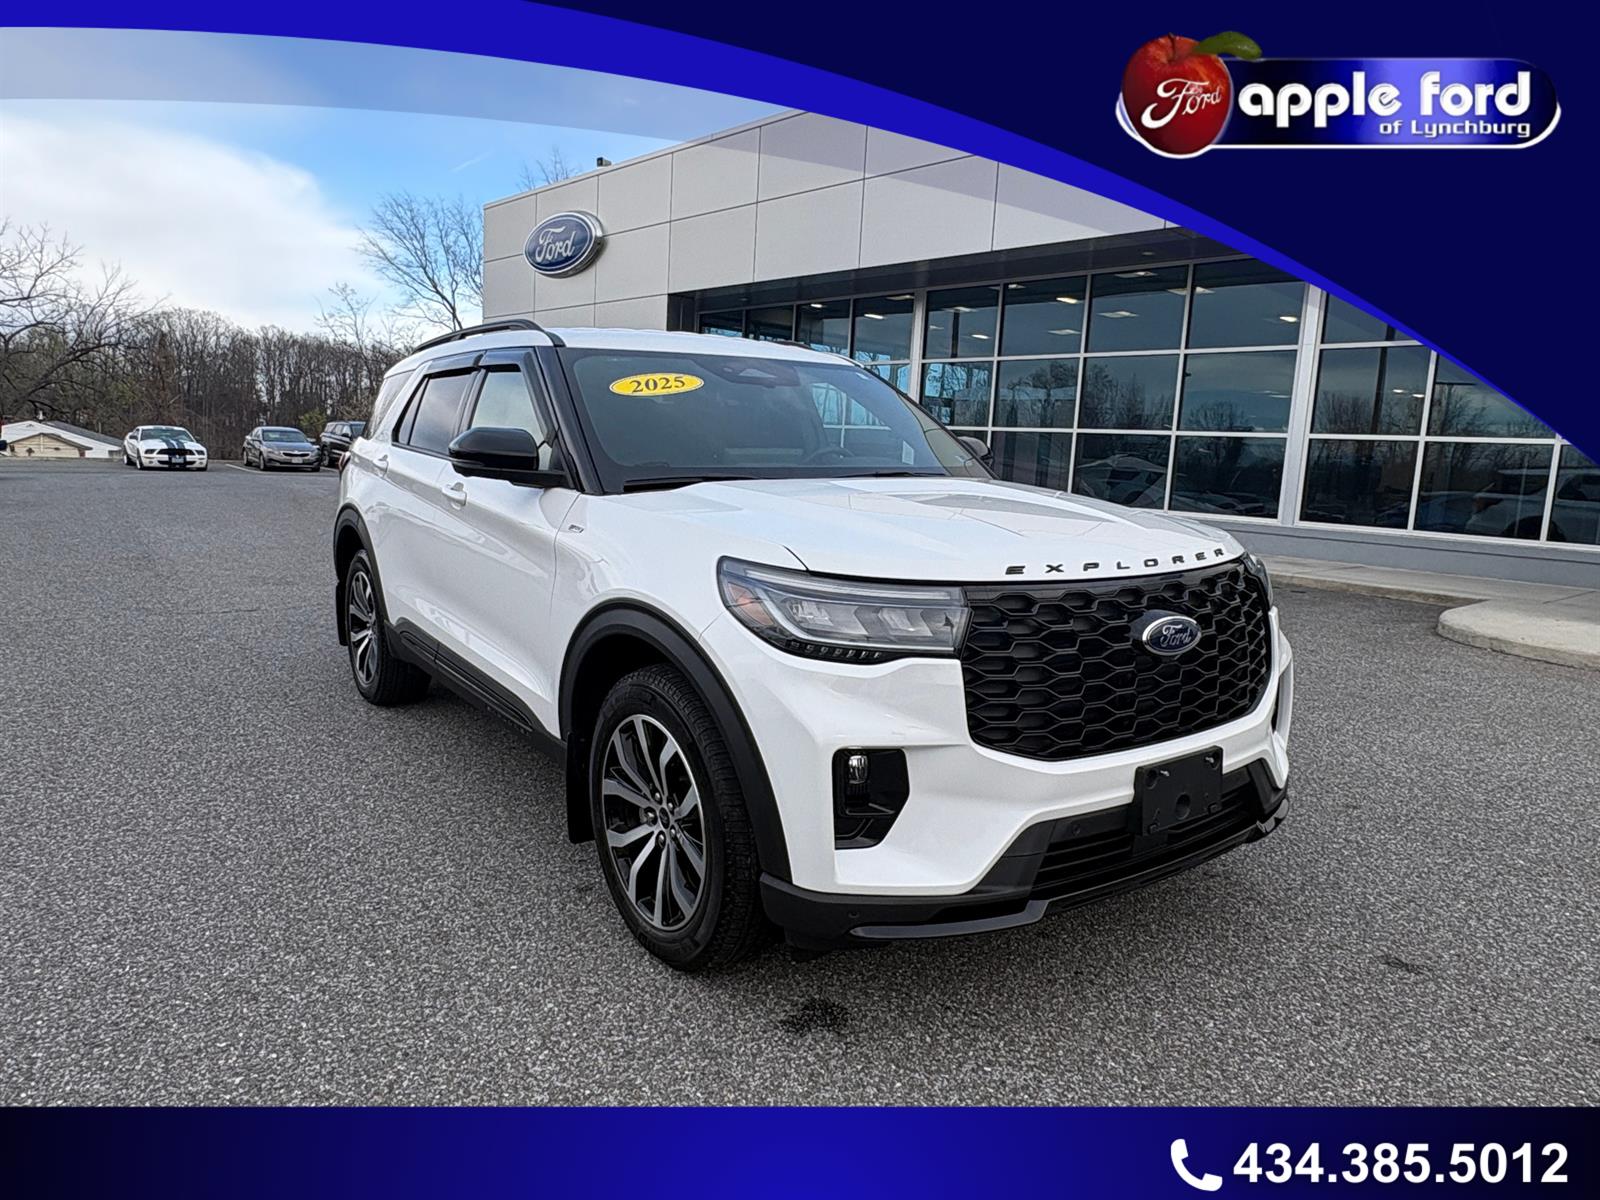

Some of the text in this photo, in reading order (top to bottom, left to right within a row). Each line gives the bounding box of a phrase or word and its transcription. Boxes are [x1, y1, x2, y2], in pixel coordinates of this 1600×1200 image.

[535, 226, 577, 262] Ford
[630, 376, 686, 393] 2025
[1005, 548, 1225, 575] EXPLORER
[1160, 624, 1194, 647] Ford
